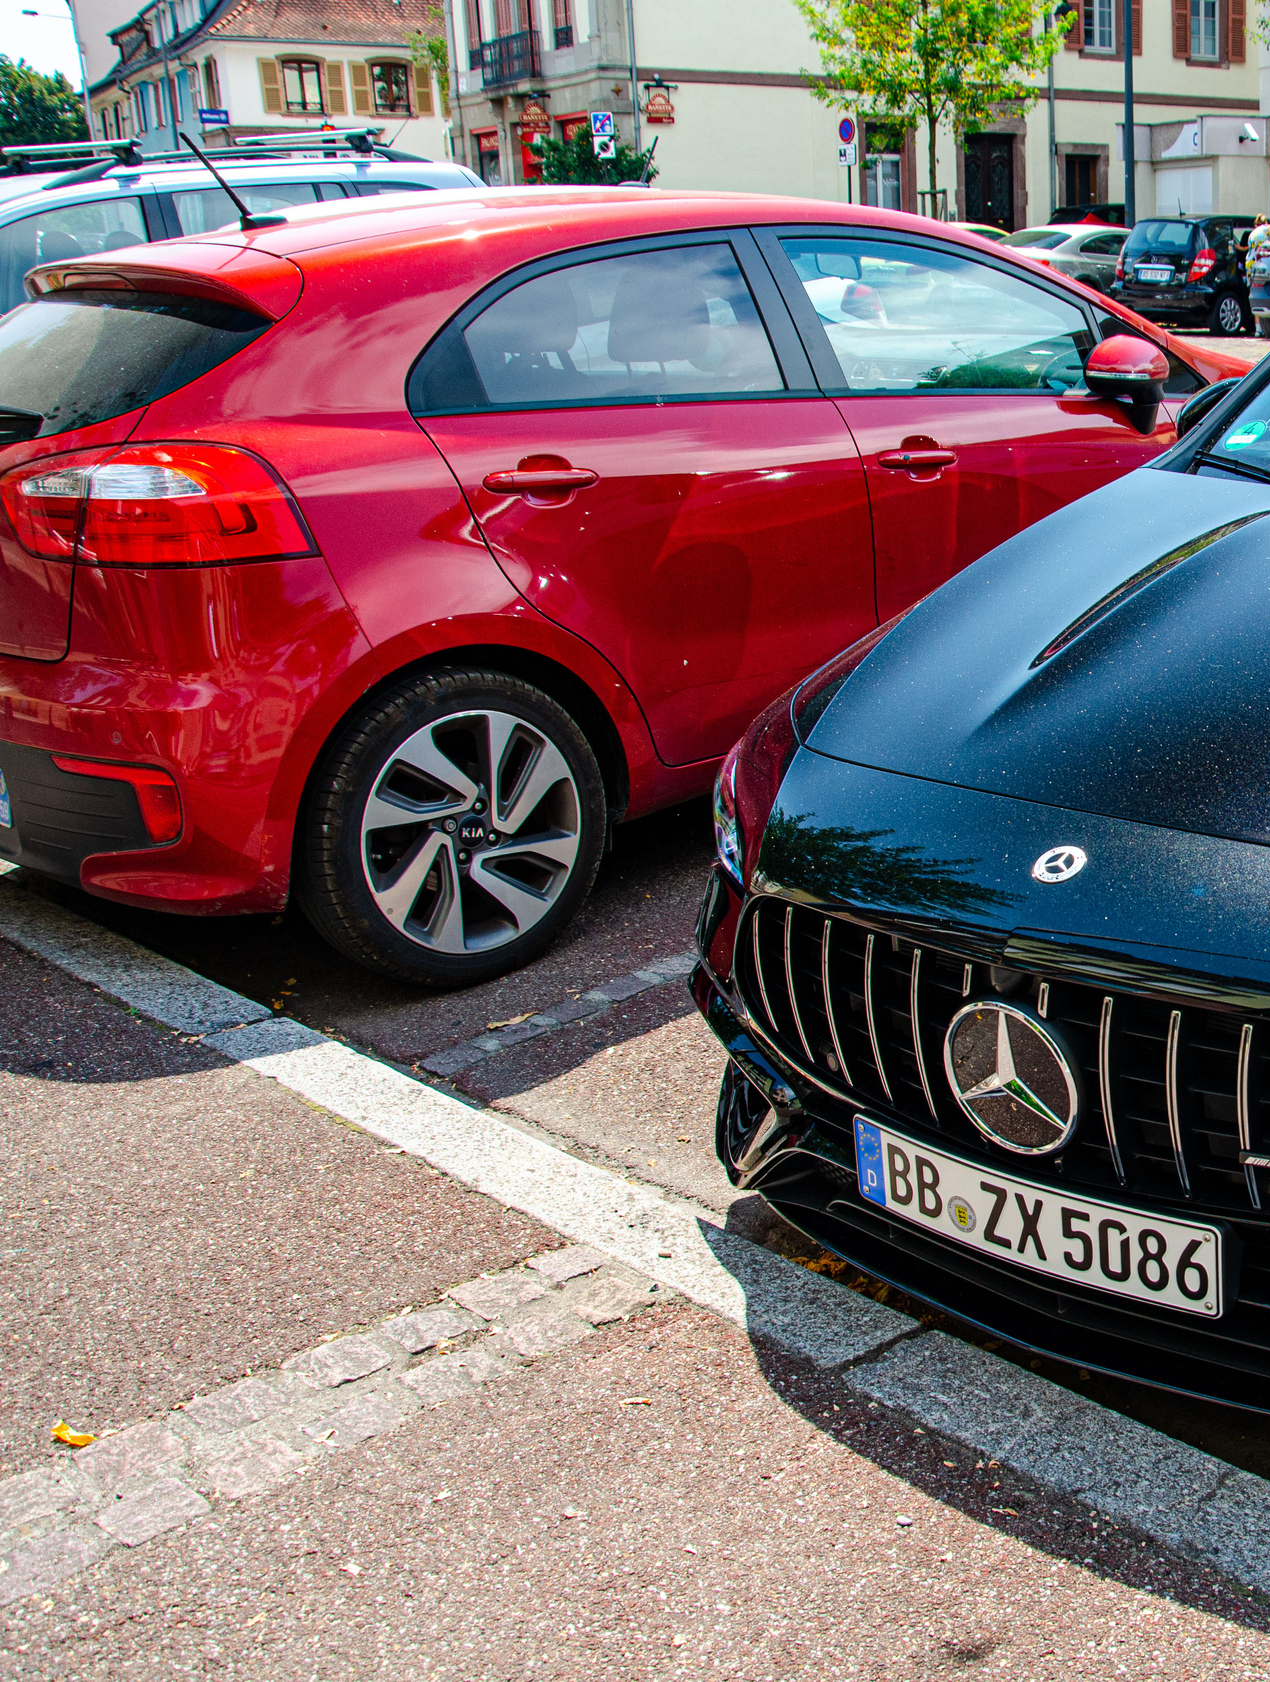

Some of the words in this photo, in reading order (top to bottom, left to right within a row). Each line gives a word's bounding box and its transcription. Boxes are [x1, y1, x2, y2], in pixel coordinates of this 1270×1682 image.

[461, 827, 484, 838] KIA
[867, 1168, 878, 1188] D
[886, 1142, 943, 1219] BB
[979, 1180, 1047, 1262] ZX
[1061, 1206, 1209, 1301] 5086
